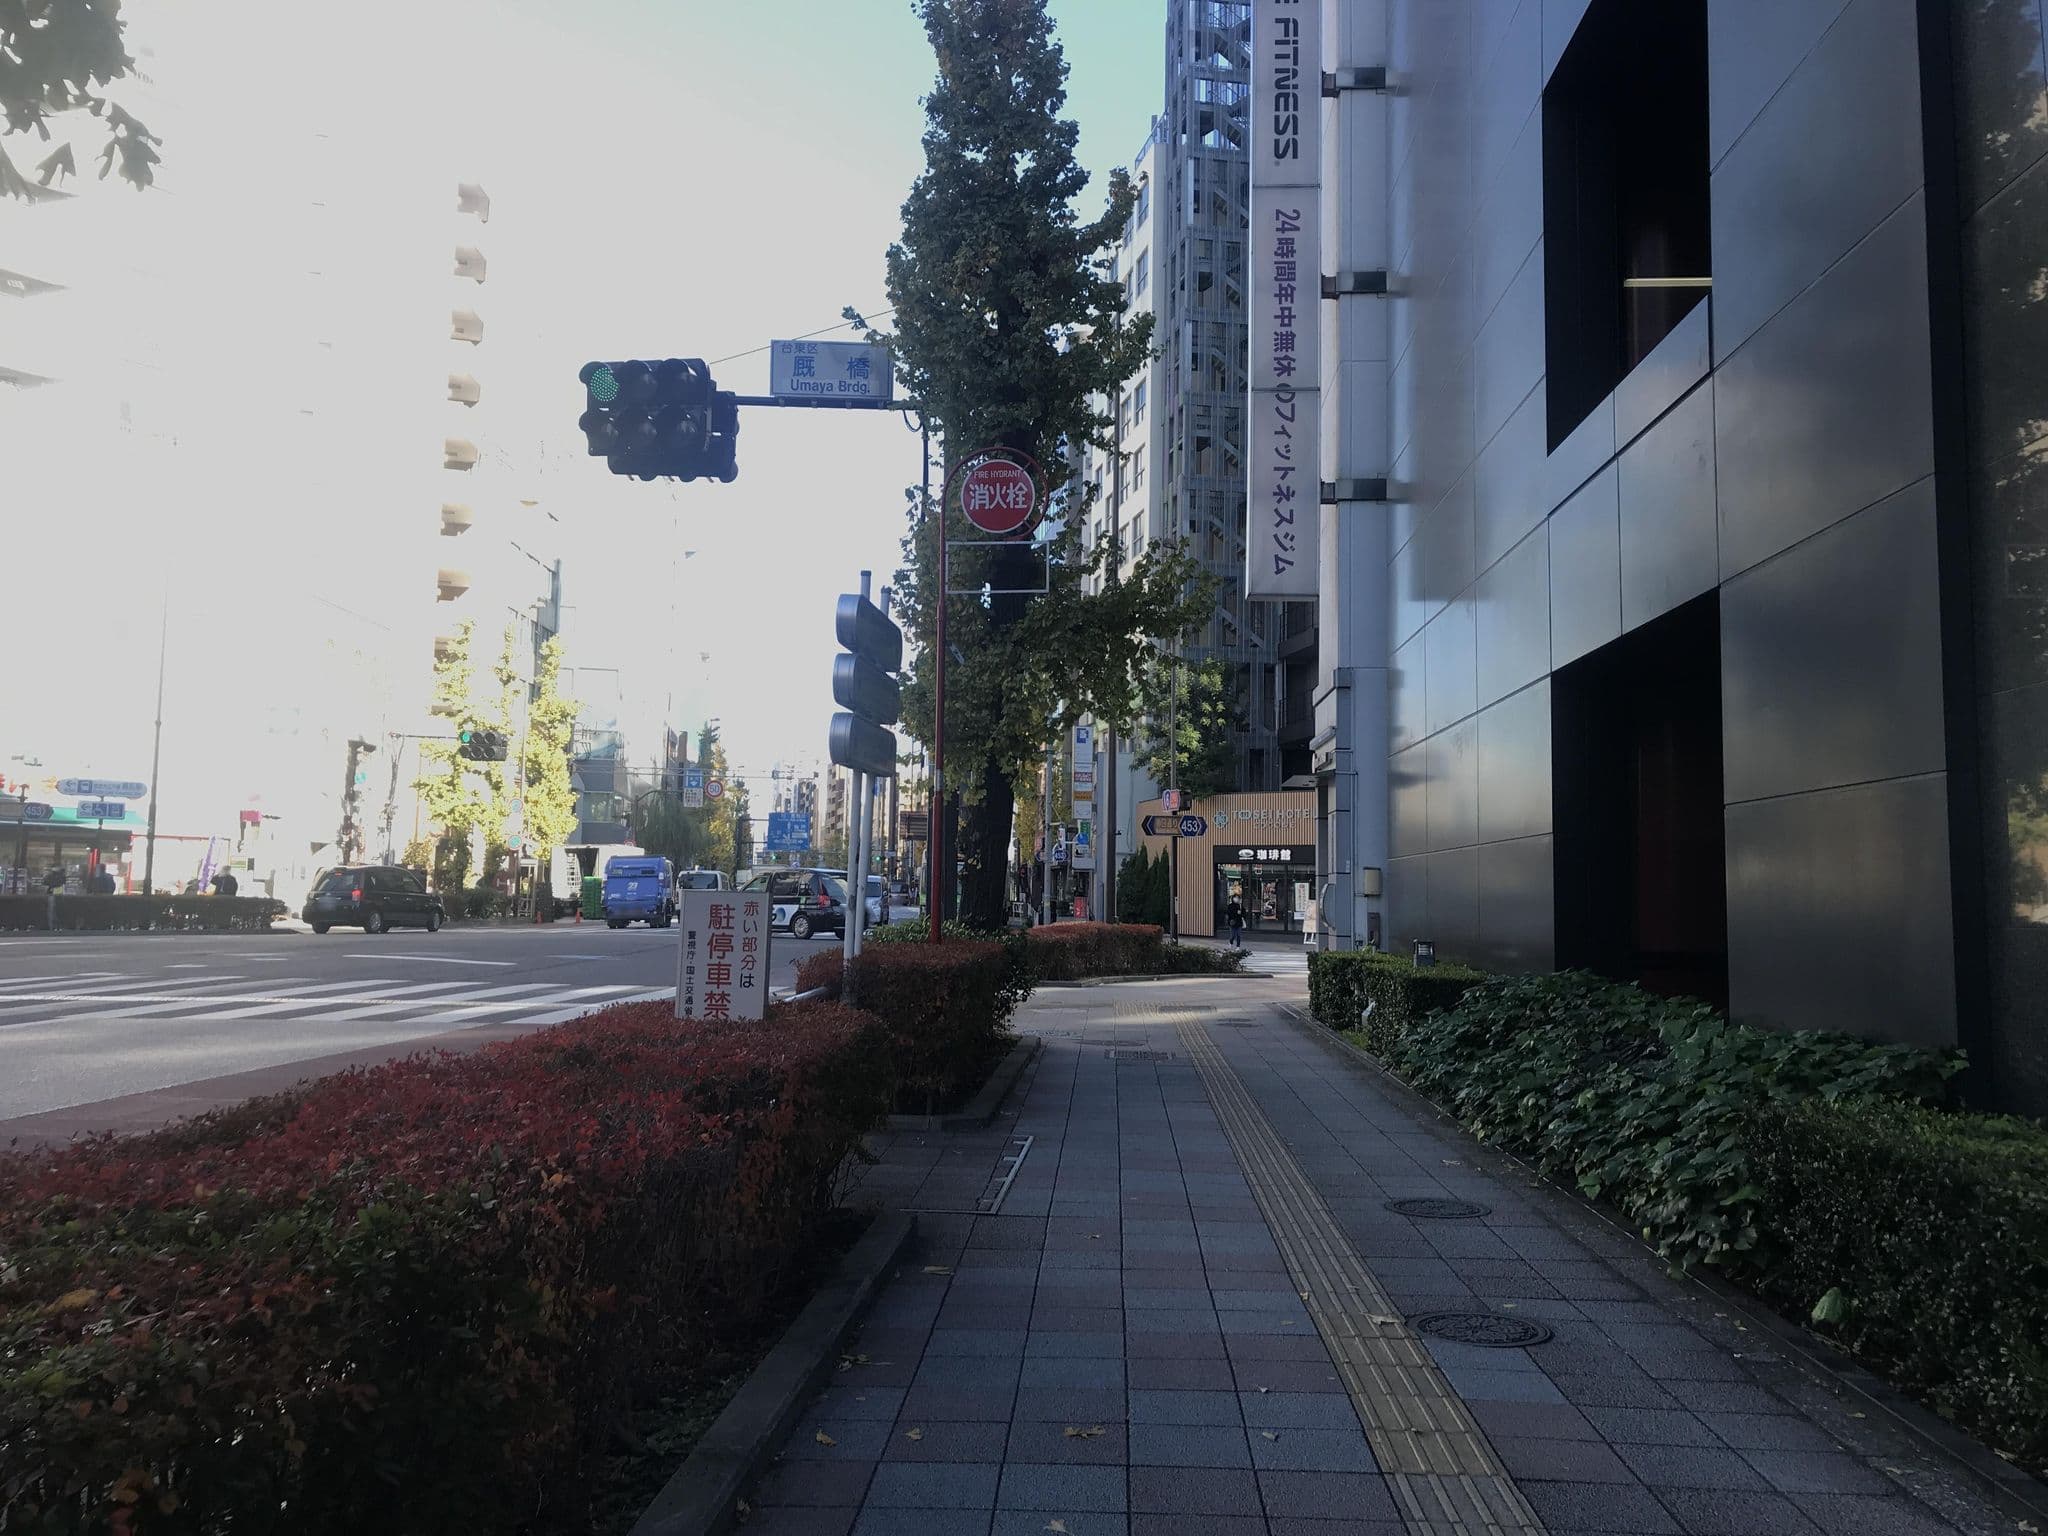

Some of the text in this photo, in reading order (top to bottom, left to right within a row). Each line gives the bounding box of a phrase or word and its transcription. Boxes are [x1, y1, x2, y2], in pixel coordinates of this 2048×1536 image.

[1274, 17, 1299, 160] FITNESS
[781, 342, 818, 354] 台東区
[790, 378, 871, 395] Umaya Brdg.
[1272, 208, 1300, 576] 24時間年中無休のフィットネスジム
[974, 469, 1020, 479] FIRE HYDRANT
[968, 481, 1028, 511] 消火栓
[709, 784, 720, 794] 50
[1181, 819, 1199, 832] 453
[1256, 848, 1292, 861] 珈琲館
[740, 901, 760, 989] 赤い部分は
